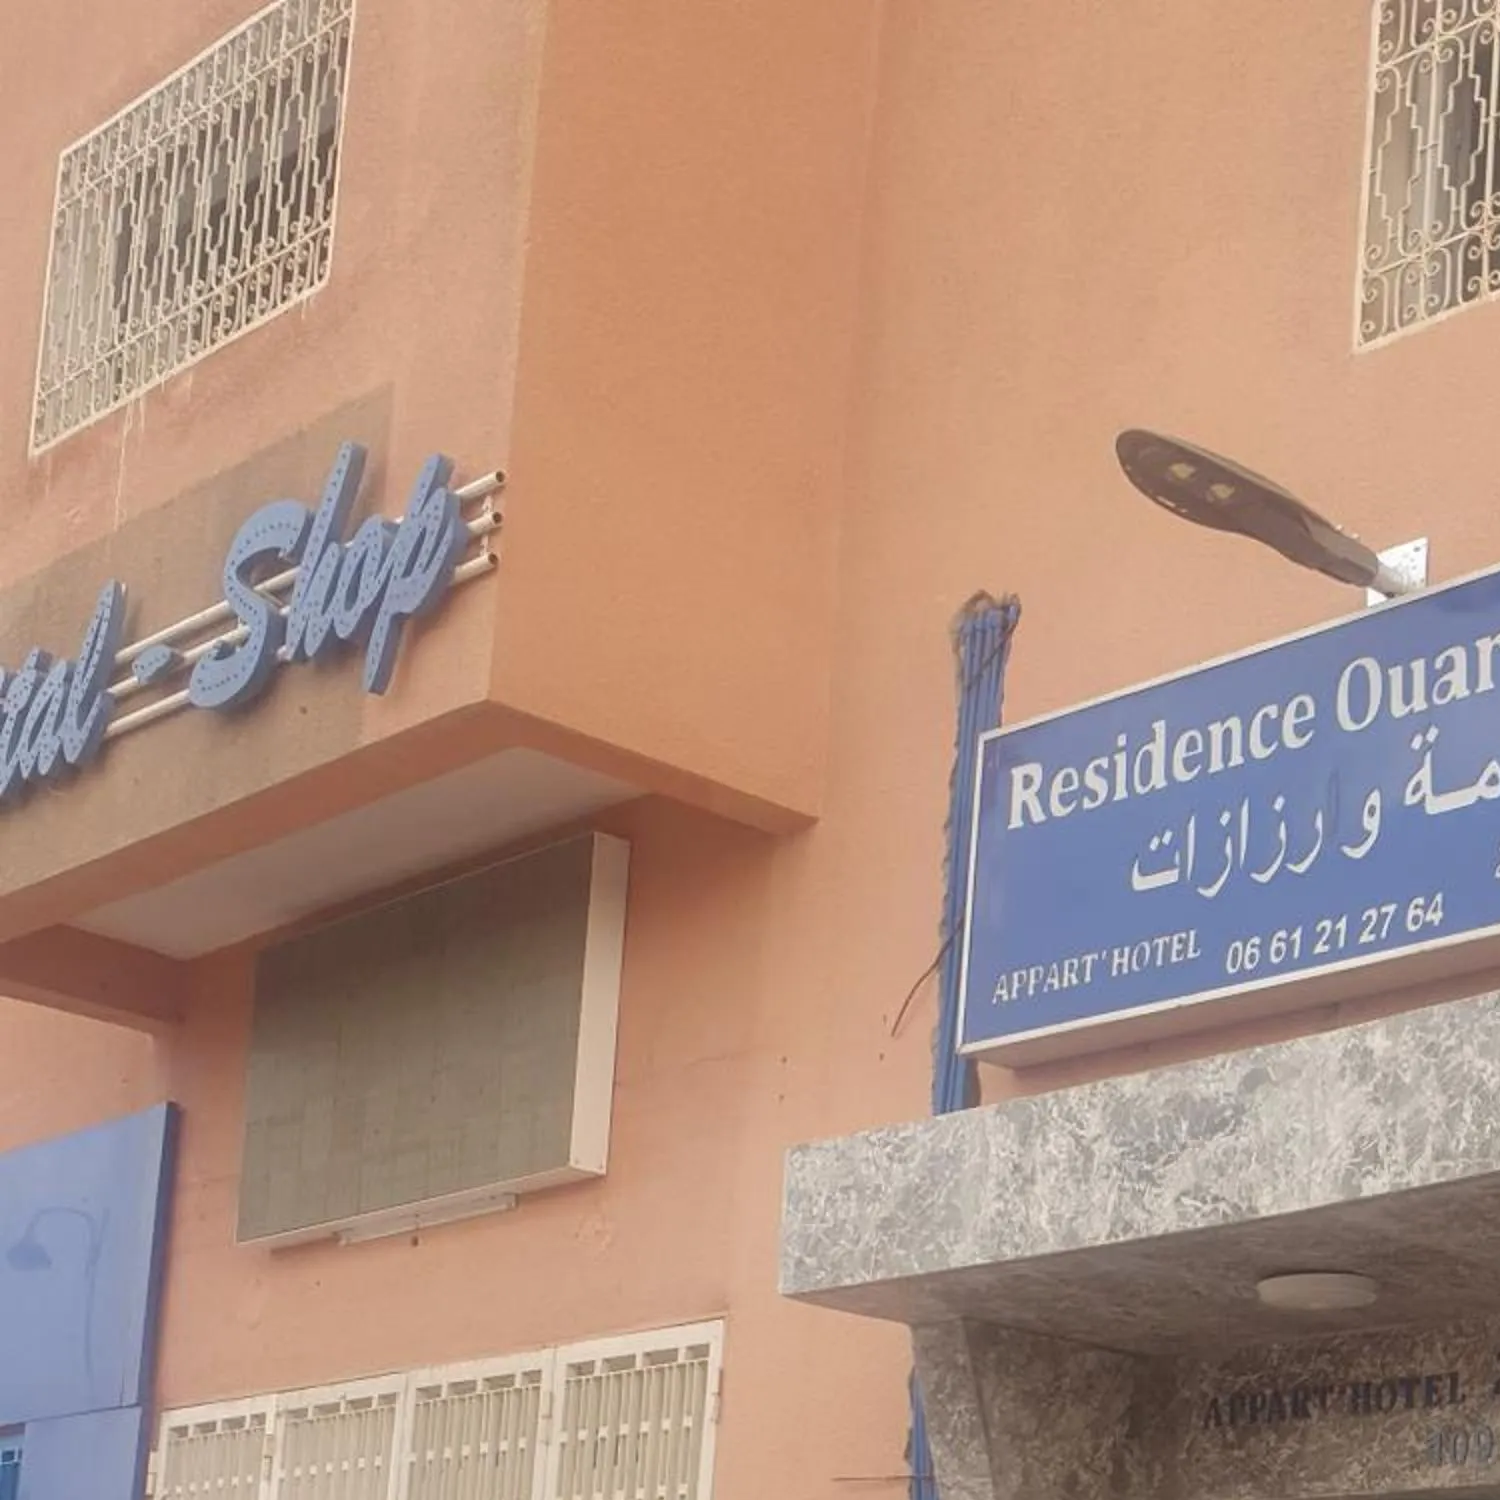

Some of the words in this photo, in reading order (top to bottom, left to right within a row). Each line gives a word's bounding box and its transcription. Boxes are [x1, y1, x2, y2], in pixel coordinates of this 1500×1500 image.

[1007, 693, 1316, 830] Residence
[1226, 935, 1261, 974] 06
[1269, 924, 1303, 965] 61
[1313, 914, 1348, 956] 21
[1358, 903, 1398, 945] 27
[1405, 892, 1444, 933] 64
